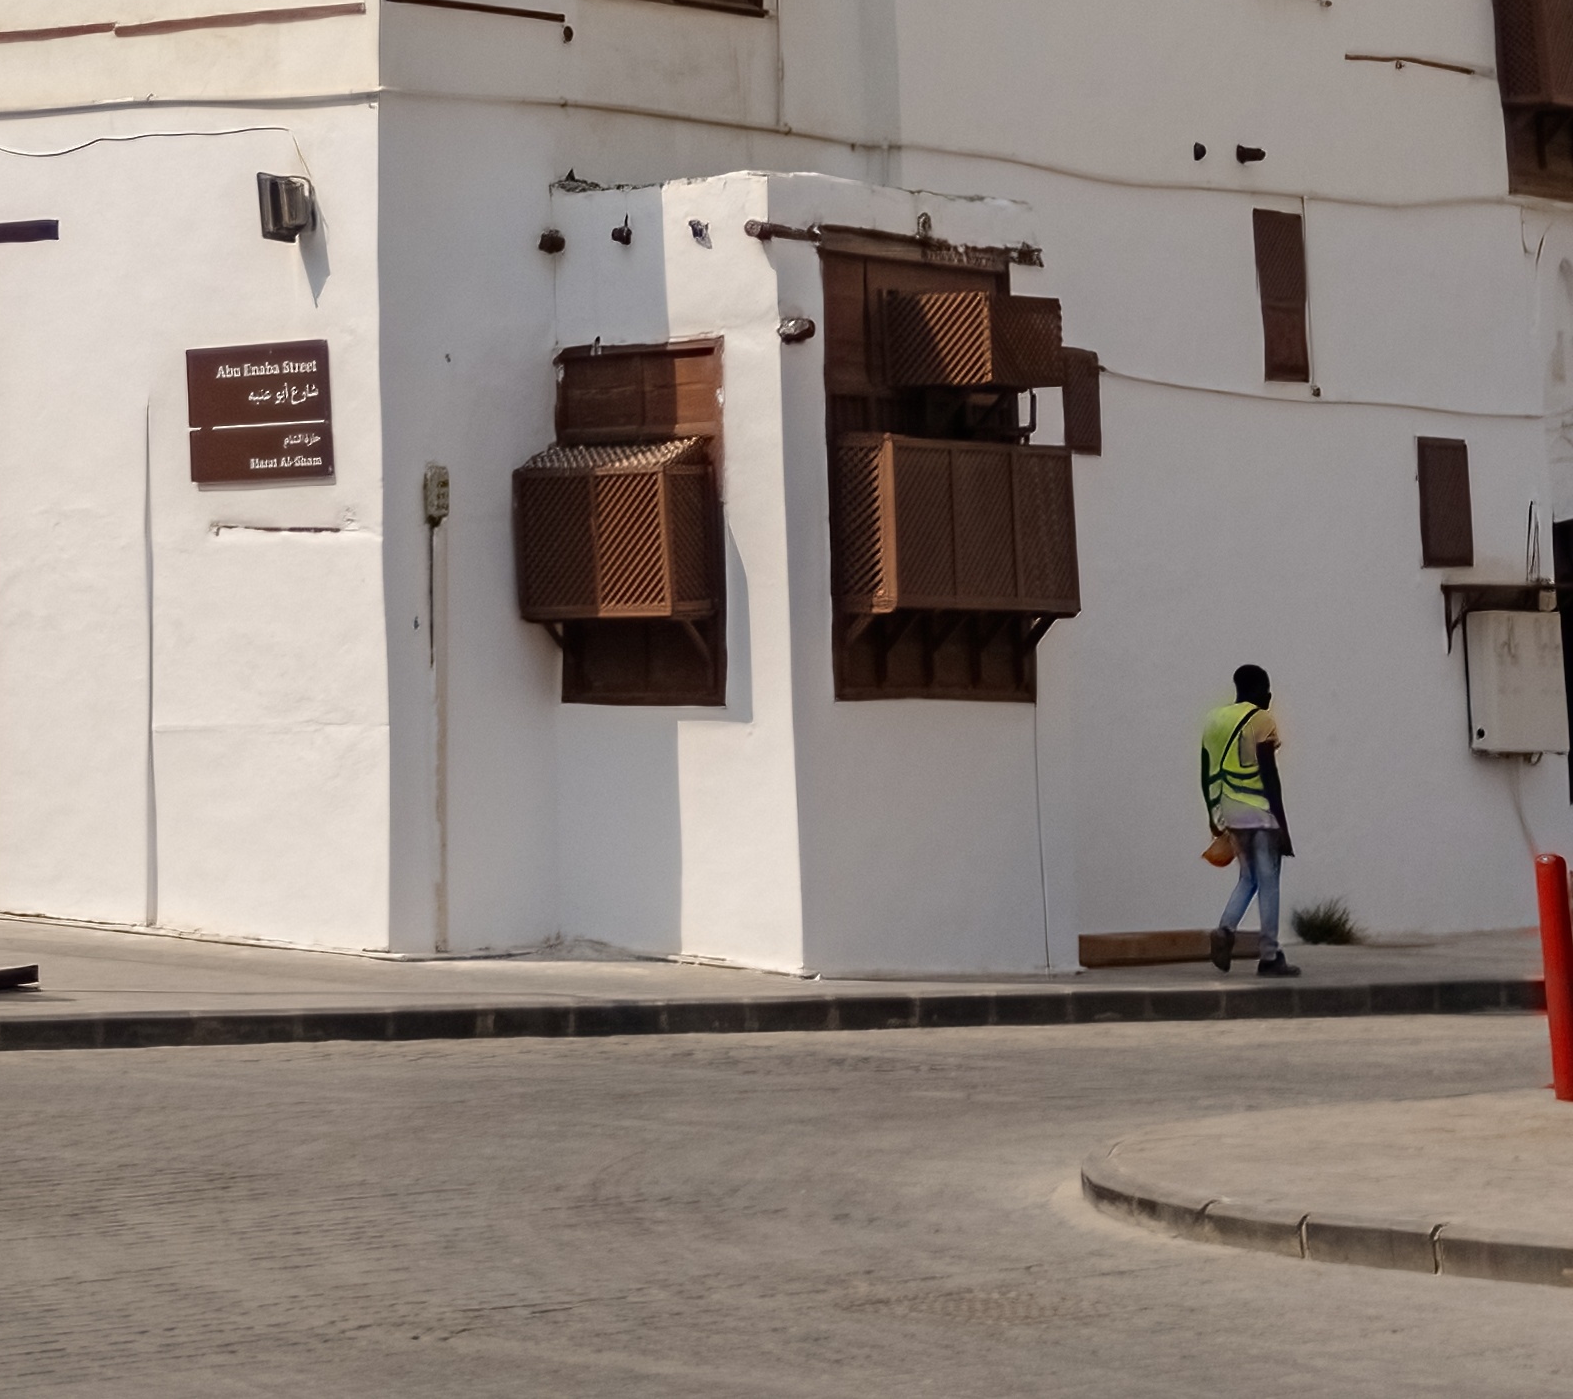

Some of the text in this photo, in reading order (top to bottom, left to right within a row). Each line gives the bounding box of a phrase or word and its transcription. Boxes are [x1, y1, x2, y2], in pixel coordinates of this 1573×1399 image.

[215, 360, 317, 379] Abu Enaba Street
[290, 384, 319, 405] شارع
